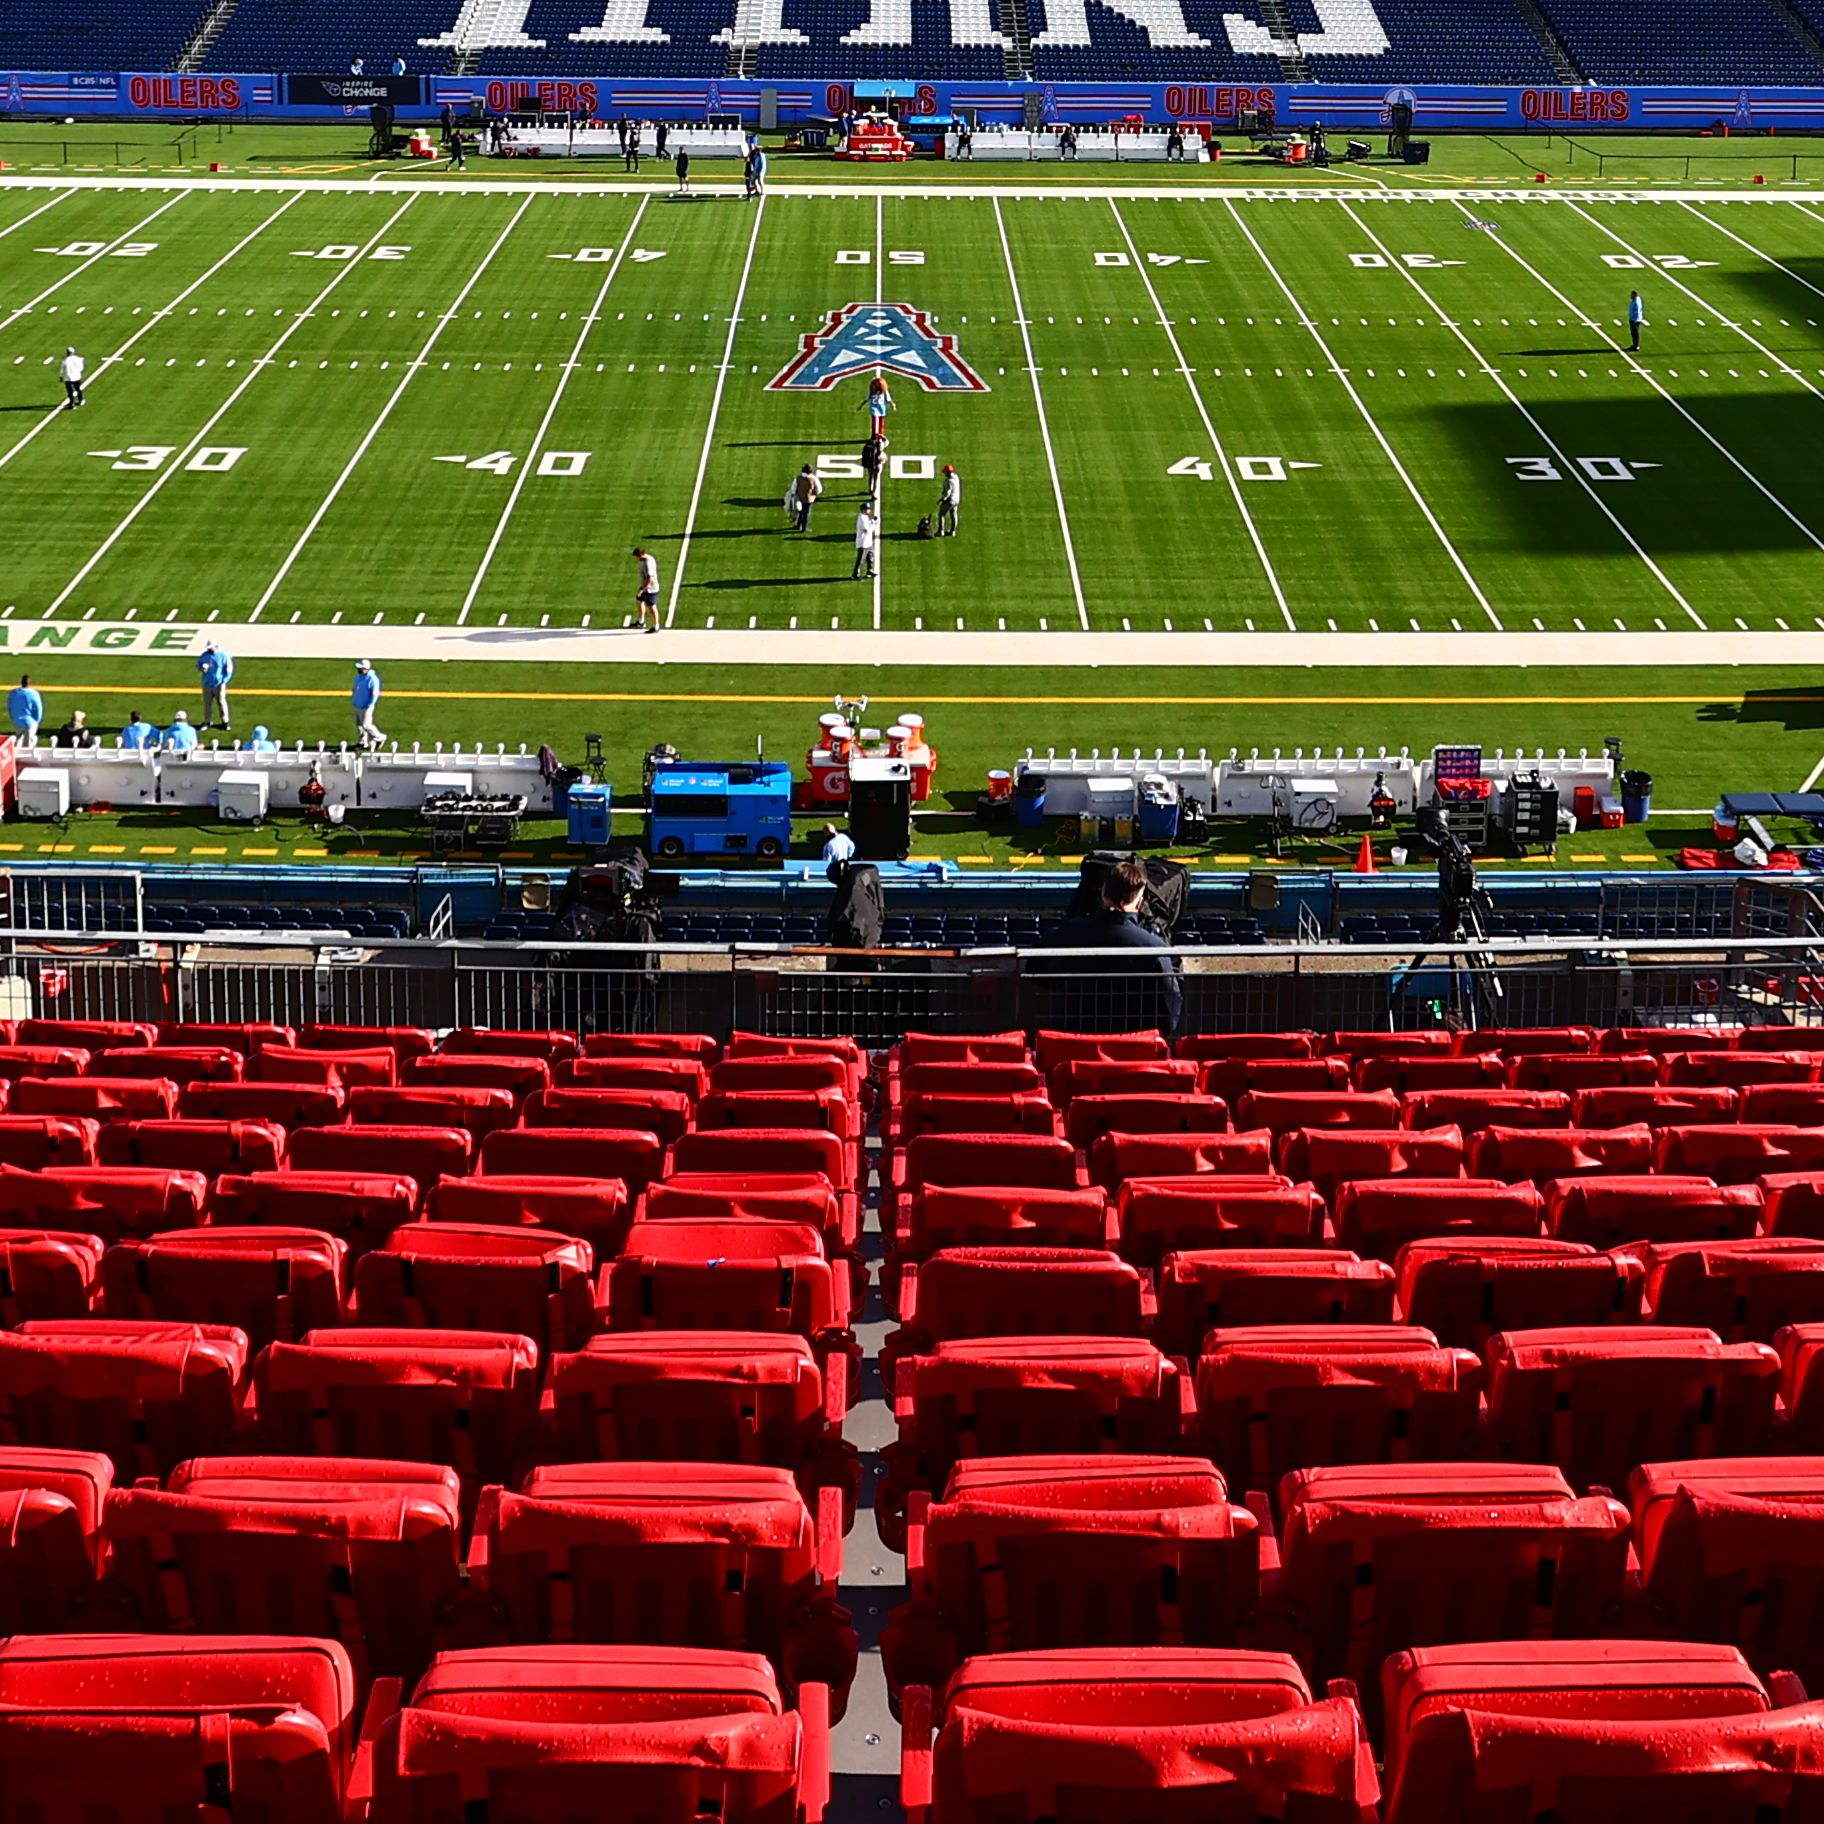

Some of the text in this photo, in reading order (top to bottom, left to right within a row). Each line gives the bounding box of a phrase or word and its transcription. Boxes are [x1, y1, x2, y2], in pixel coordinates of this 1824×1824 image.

[129, 75, 242, 110] OILERS
[341, 80, 374, 88] INSPIRE
[341, 86, 388, 97] CHANGE
[1164, 85, 1277, 118] OILERS
[1520, 89, 1630, 122] OILERS
[1244, 189, 1648, 200] INSPIRE CHANGE
[111, 446, 249, 472] 30
[464, 450, 591, 476] 40
[816, 455, 937, 480] 50
[1167, 456, 1285, 482] 40
[1506, 456, 1641, 482] 30
[823, 771, 848, 794] G
